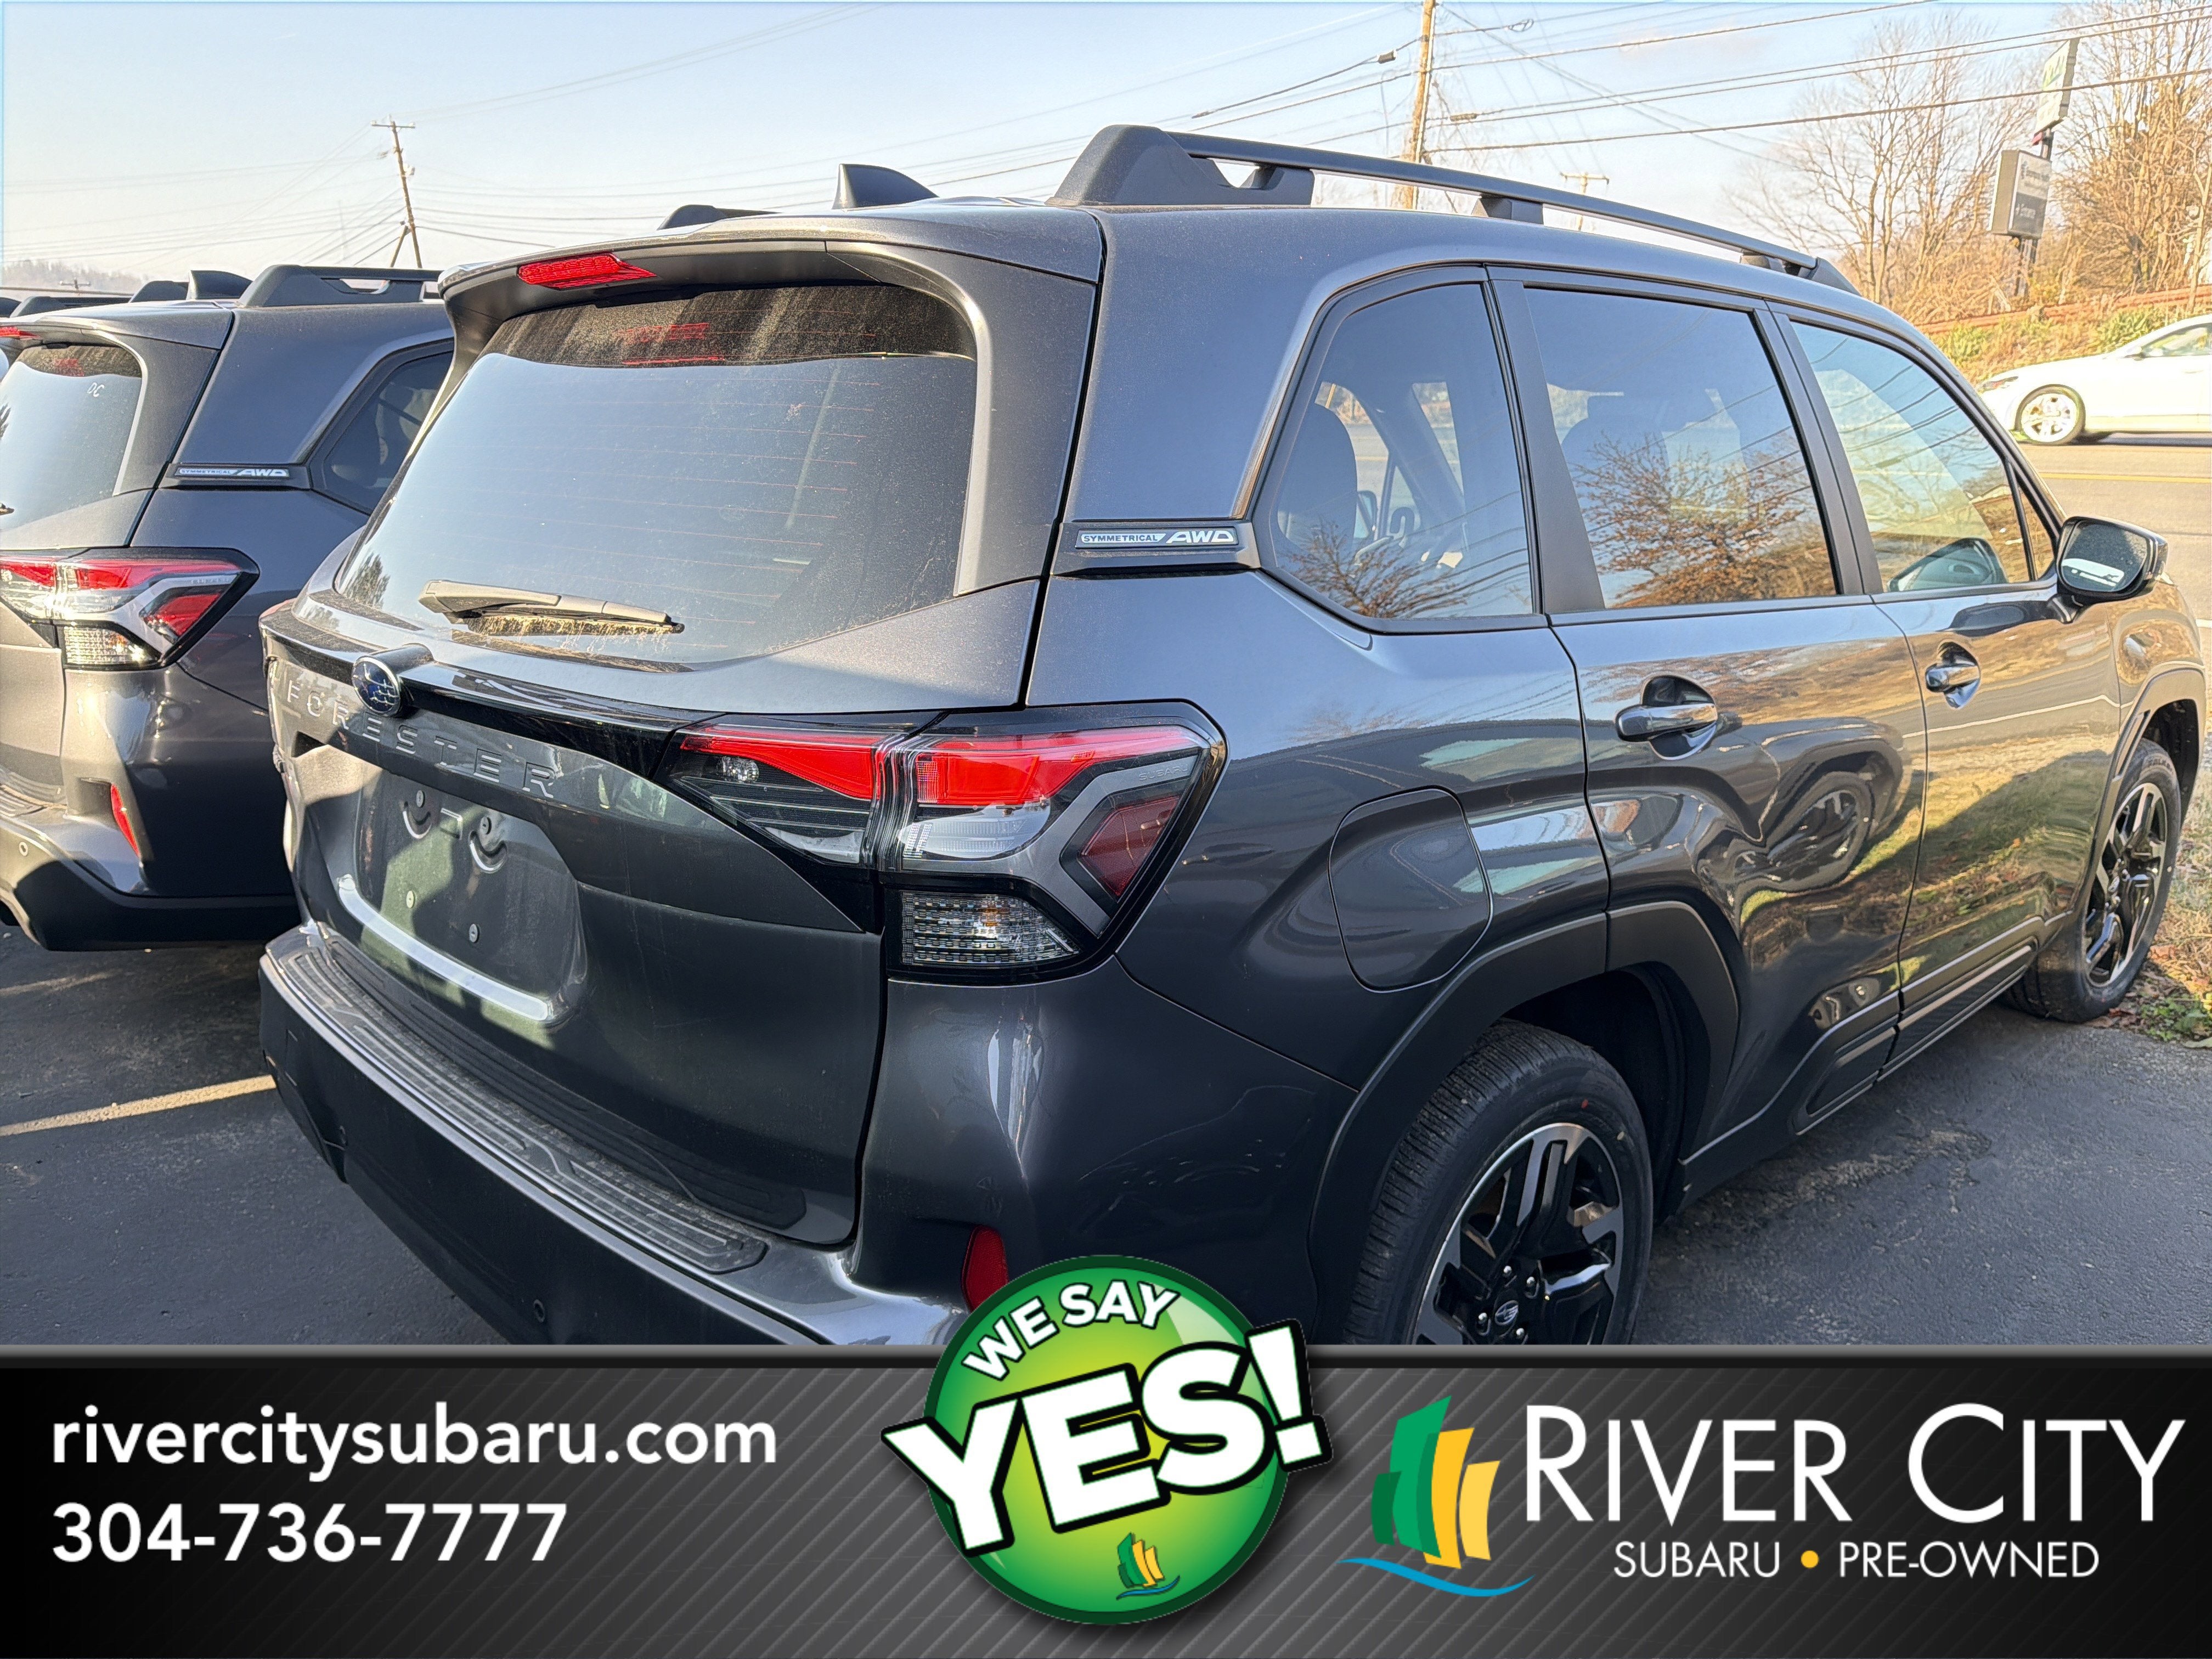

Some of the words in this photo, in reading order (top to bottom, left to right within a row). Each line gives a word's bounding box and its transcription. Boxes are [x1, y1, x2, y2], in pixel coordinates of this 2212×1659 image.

[236, 469, 289, 477] AWD
[1083, 534, 1159, 543] SYMMETRICAL
[1166, 530, 1234, 544] AWD
[286, 679, 555, 799] FORESTER
